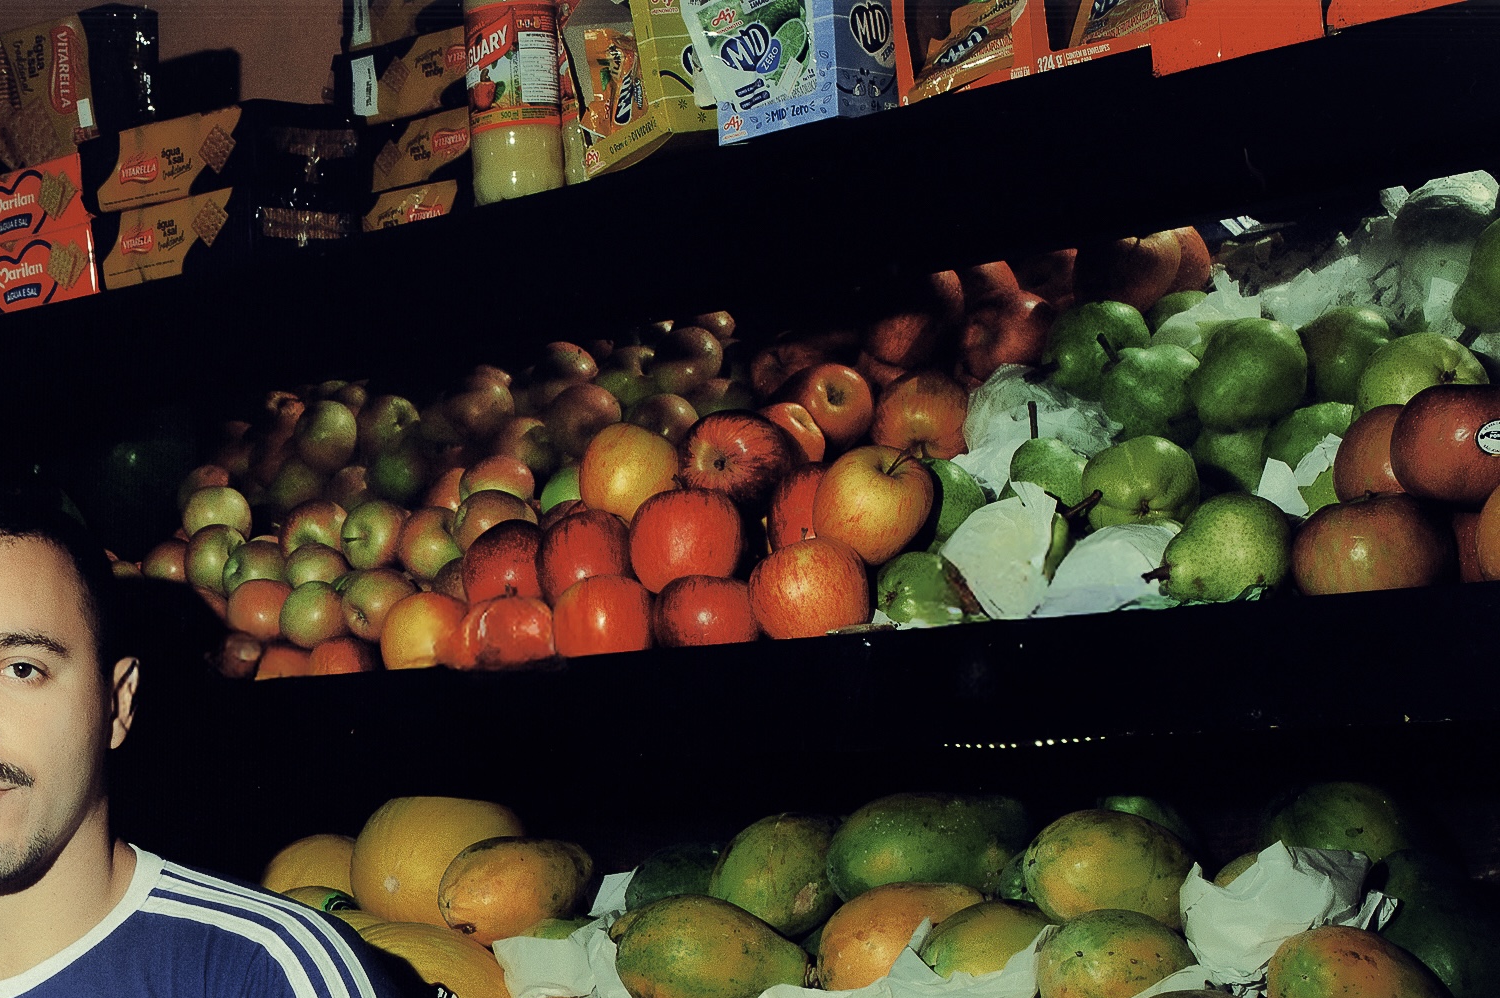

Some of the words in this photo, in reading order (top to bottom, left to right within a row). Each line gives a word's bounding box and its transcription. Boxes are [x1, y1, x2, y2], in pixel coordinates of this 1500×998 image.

[467, 24, 508, 68] GUARY
[726, 26, 766, 72] MID
[855, 10, 887, 49] MID
[56, 31, 72, 109] VITARELLA
[761, 47, 779, 71] ZERO
[791, 104, 809, 119] Zero
[121, 162, 157, 178] VITARELLA
